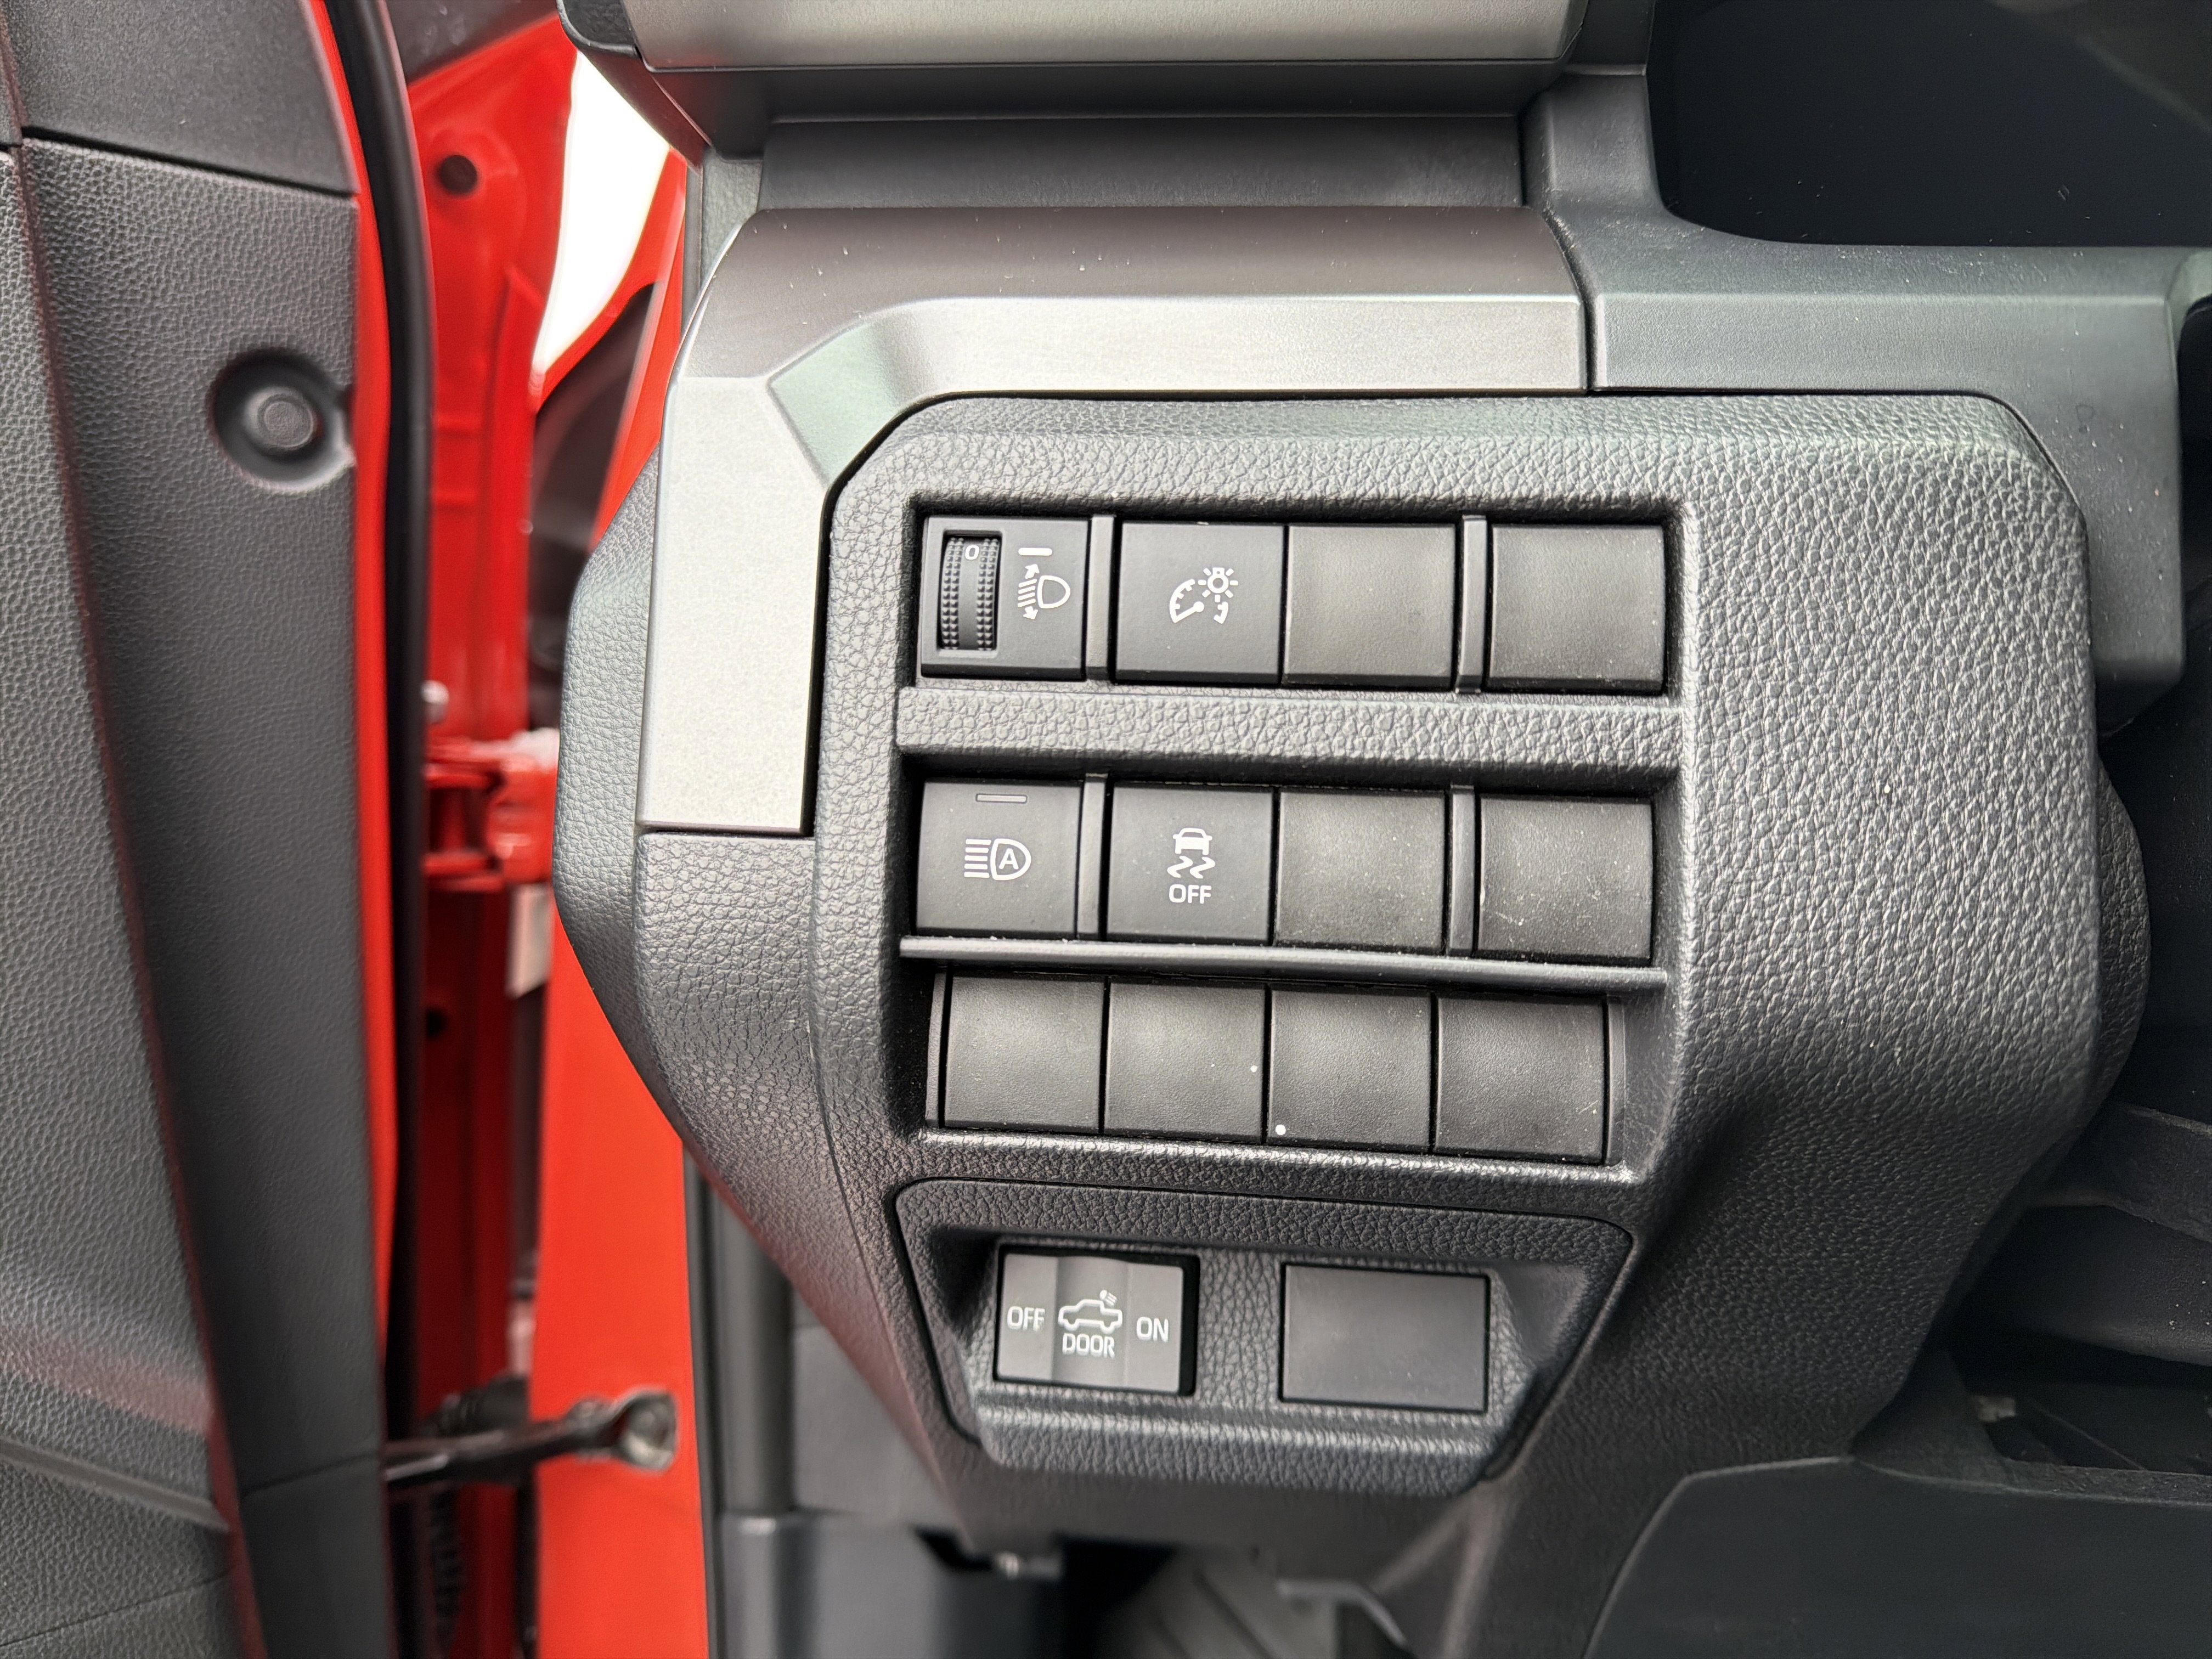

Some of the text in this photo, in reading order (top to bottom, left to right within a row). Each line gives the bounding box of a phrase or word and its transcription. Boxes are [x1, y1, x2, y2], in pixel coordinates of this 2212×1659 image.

[998, 848, 1019, 870] A
[1169, 884, 1212, 904] OFF
[1007, 1306, 1045, 1331] OFF
[1136, 1317, 1169, 1342] ON
[1062, 1333, 1115, 1358] DOOR
